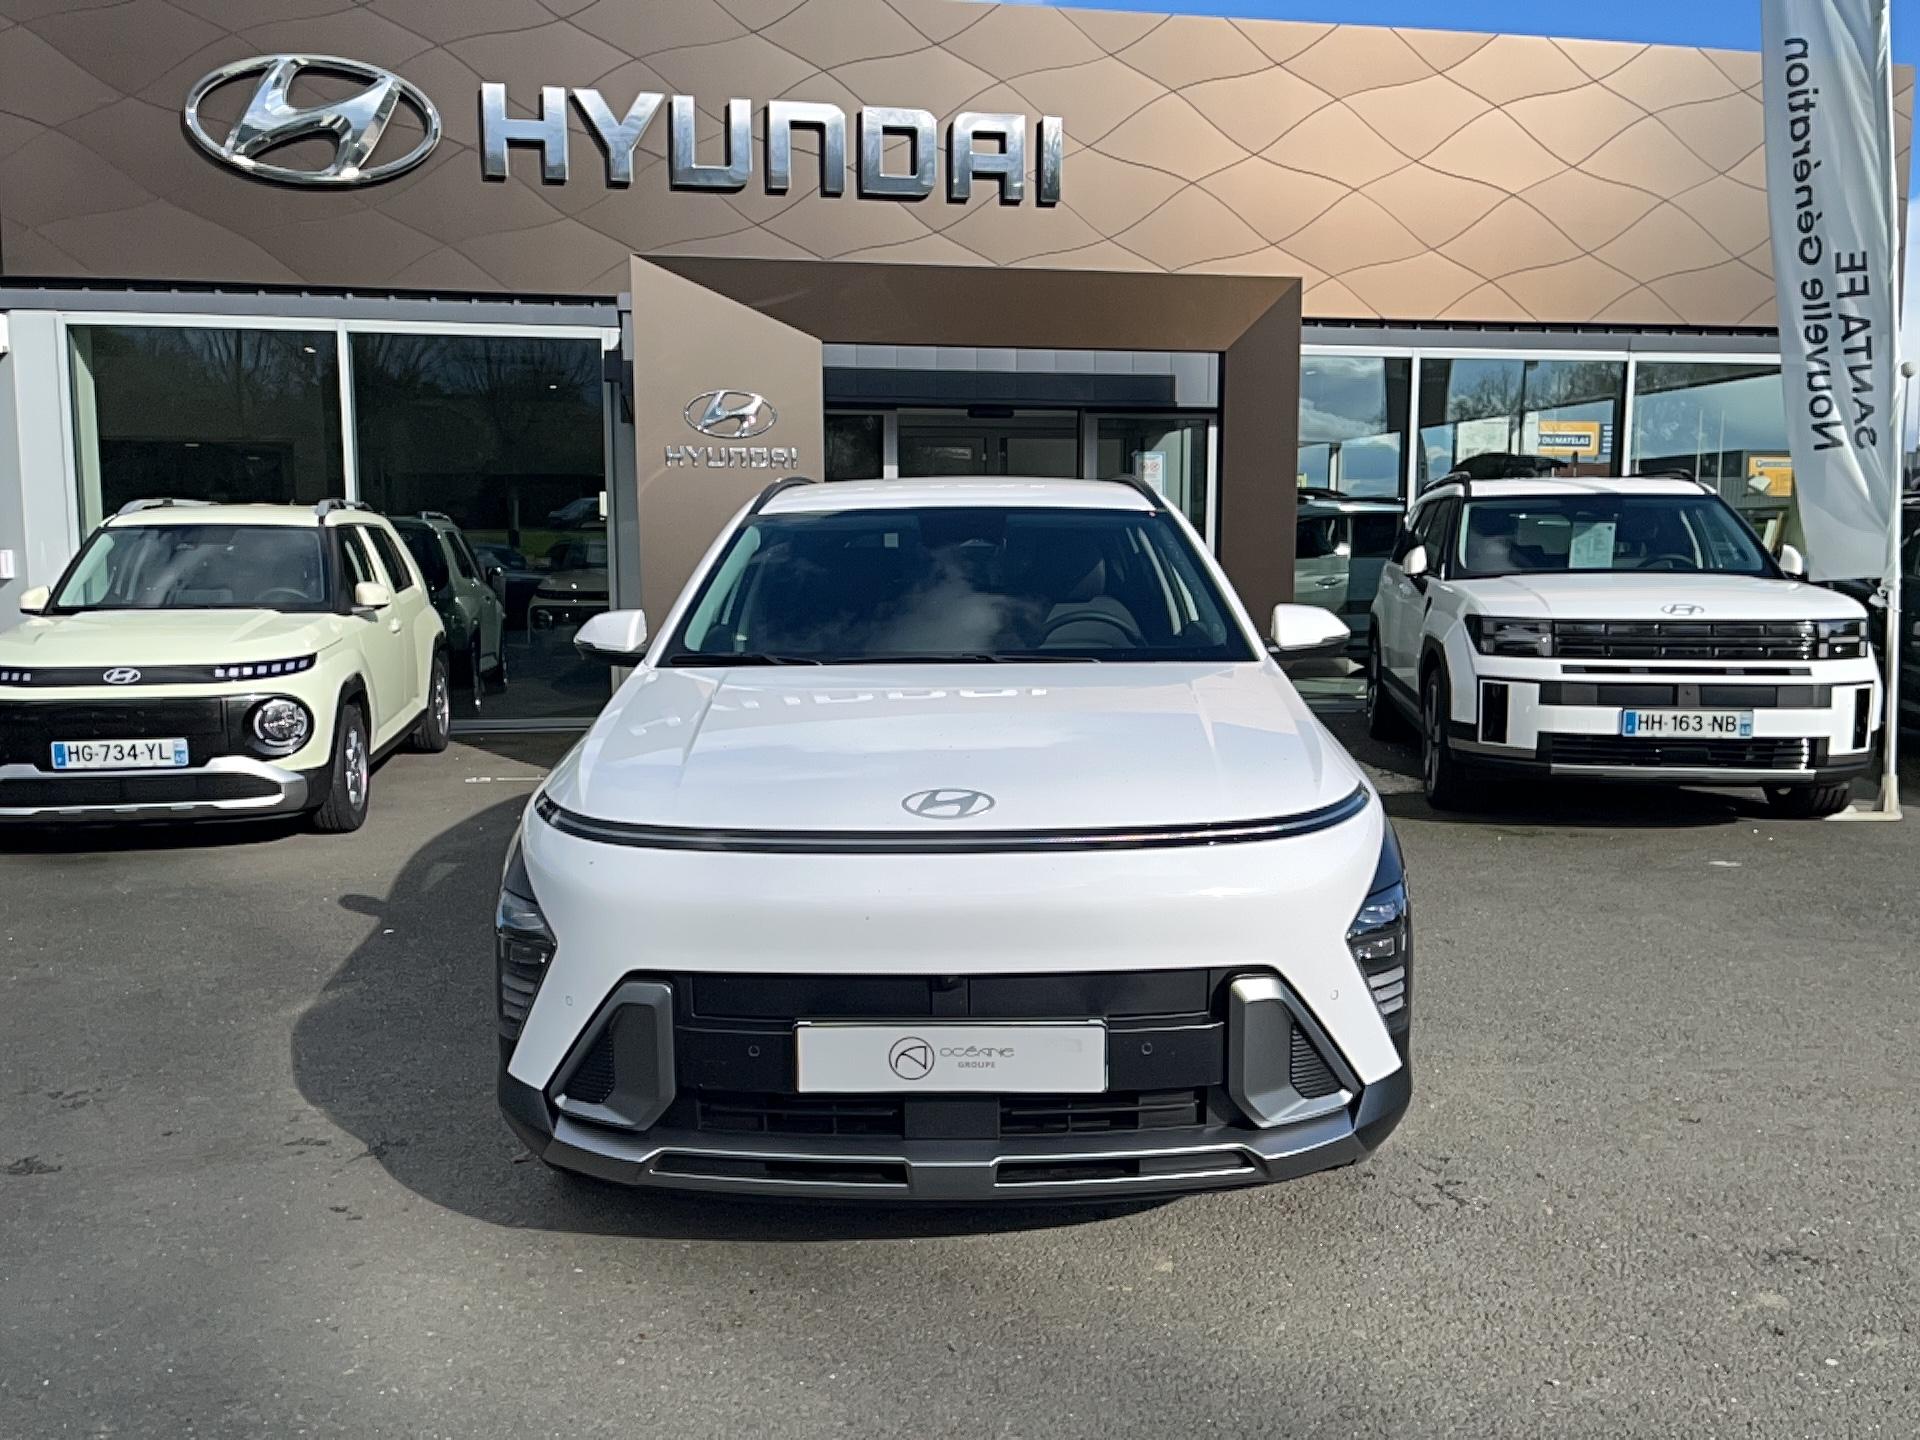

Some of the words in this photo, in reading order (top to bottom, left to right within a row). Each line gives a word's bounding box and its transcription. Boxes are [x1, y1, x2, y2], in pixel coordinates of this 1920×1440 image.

[478, 81, 1064, 206] HYUNDAI
[665, 445, 799, 469] HYUNDAI
[68, 743, 171, 762] HG-734-YL
[958, 1061, 996, 1069] GROUPE
